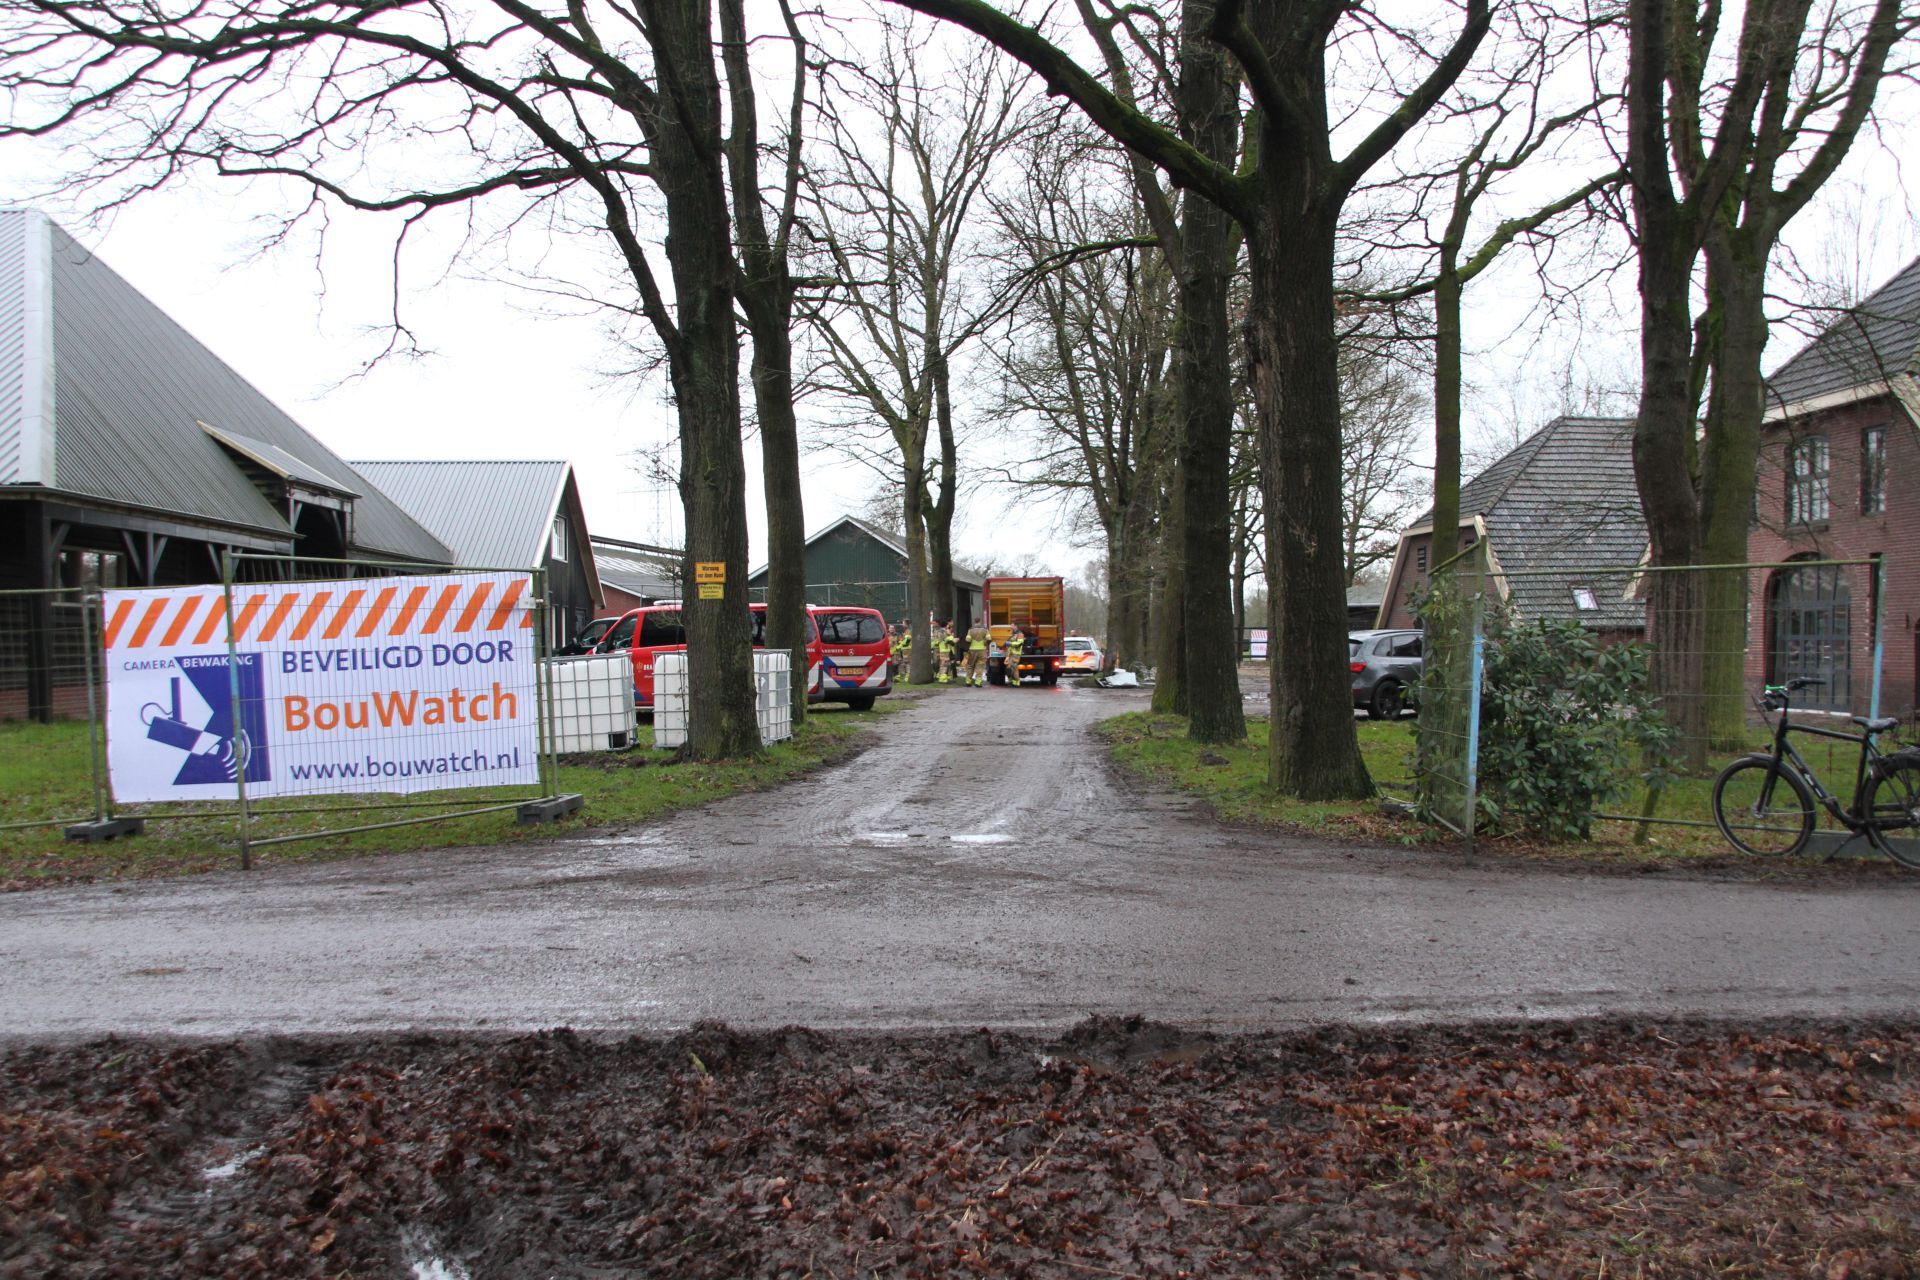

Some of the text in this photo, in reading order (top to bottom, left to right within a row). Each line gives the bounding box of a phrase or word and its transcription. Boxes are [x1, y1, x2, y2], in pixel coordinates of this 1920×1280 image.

[123, 655, 253, 671] CAMERA BEWAKNG
[282, 640, 514, 673] BEVEILIGD DOOR
[284, 682, 517, 731] BouWatch
[291, 747, 520, 780] www.bouwatch.nl
